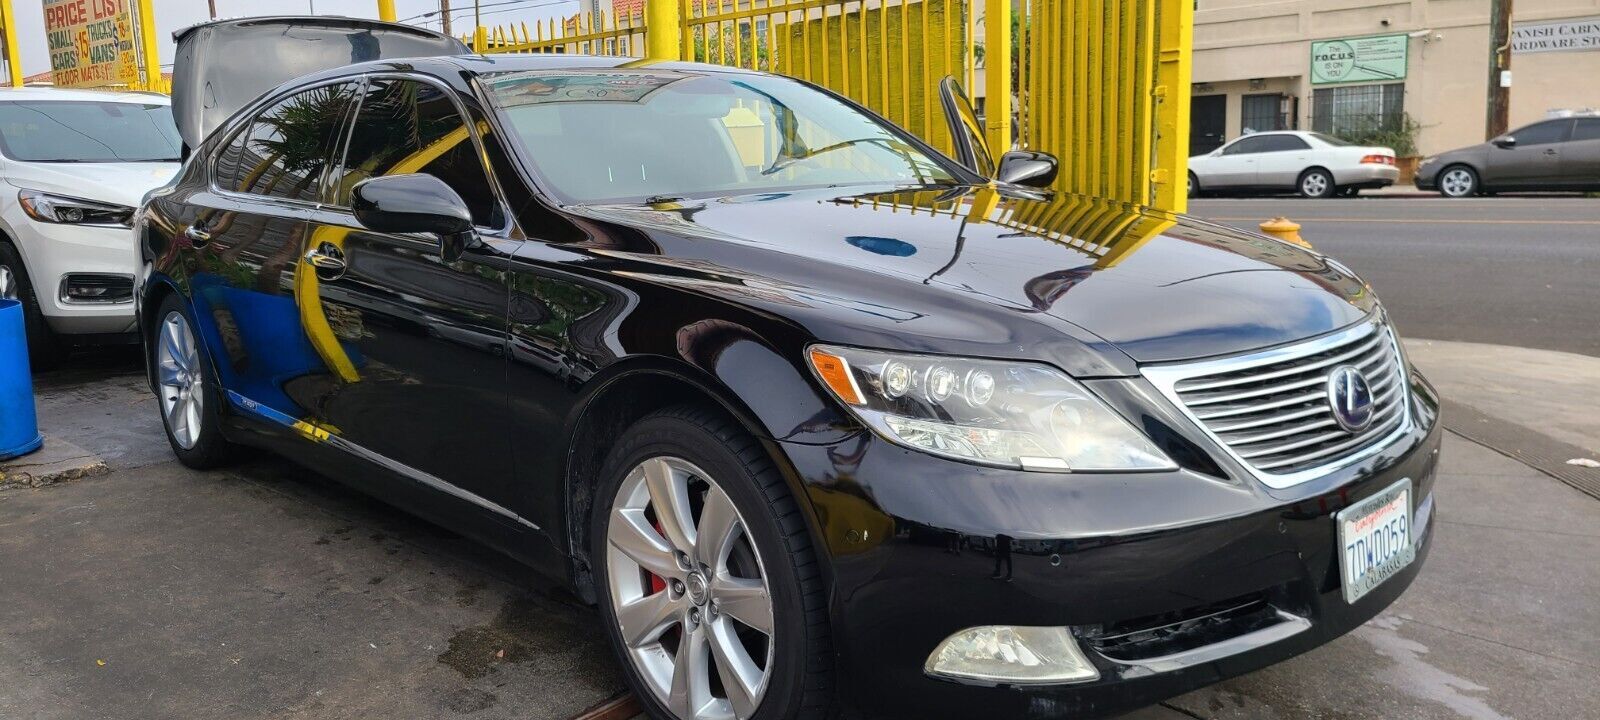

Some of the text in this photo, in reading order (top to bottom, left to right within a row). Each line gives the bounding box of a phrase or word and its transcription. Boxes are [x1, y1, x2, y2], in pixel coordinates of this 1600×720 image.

[46, 0, 122, 30] PRICE LIST
[48, 29, 74, 50] SMALL
[86, 20, 113, 42] TRUCKS
[51, 50, 77, 71] CARS
[88, 43, 116, 64] VANS
[56, 67, 79, 86] FLOOR
[80, 64, 101, 82] MATS
[1346, 514, 1406, 582] 7DWD059
[1365, 558, 1402, 590] CALABASAS
